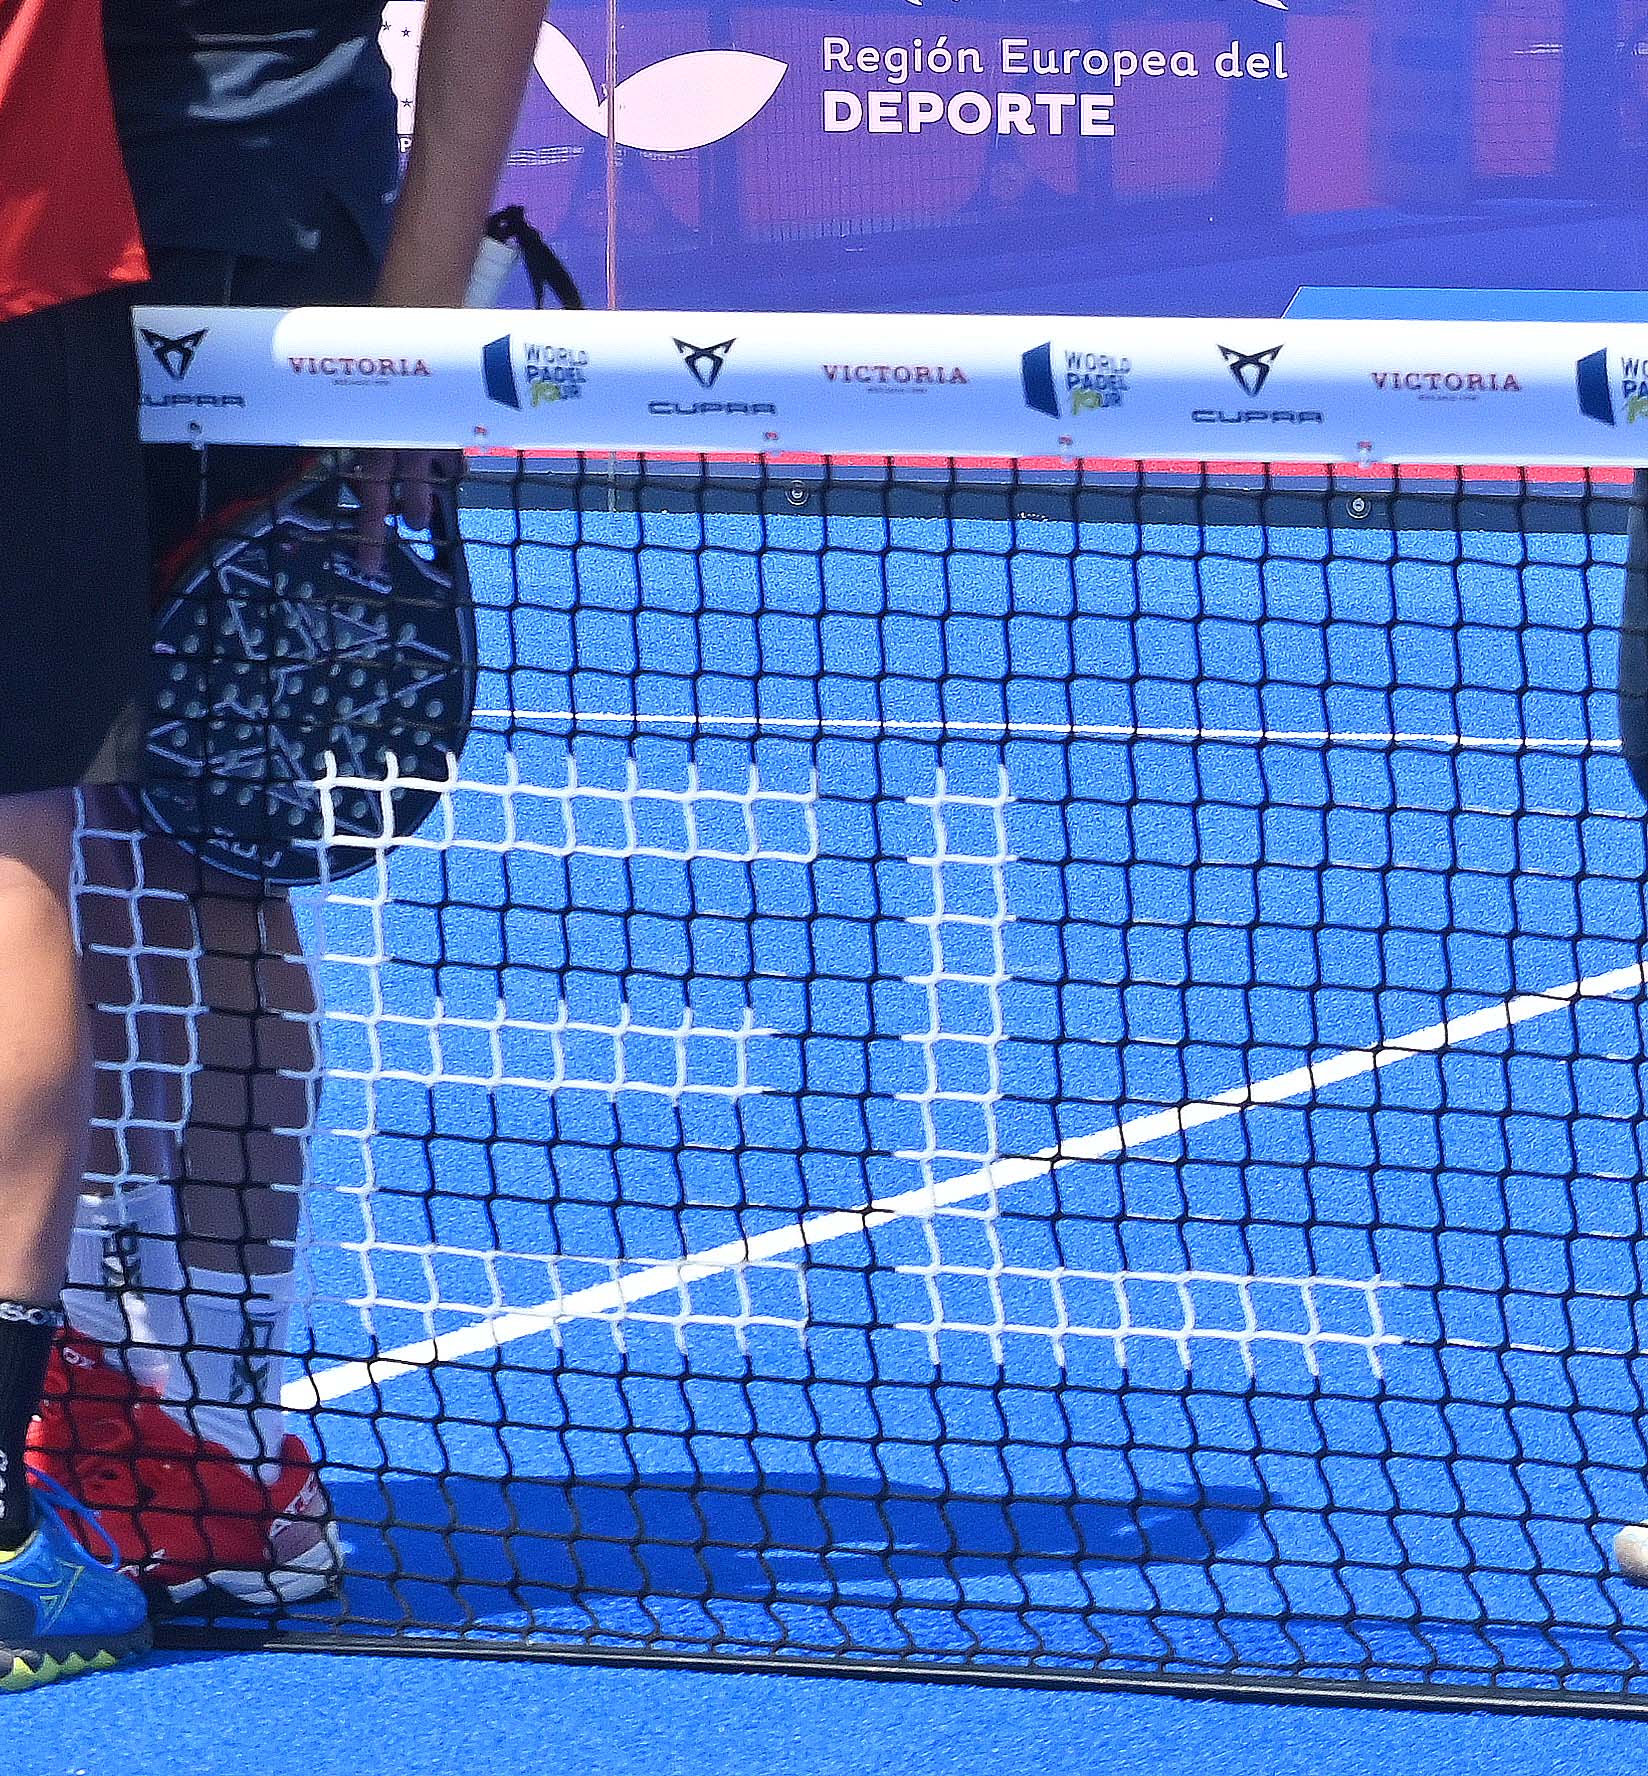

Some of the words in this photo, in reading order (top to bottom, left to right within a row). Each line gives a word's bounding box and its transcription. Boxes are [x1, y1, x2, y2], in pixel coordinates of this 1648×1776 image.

[822, 35, 985, 85] Región
[1002, 38, 1200, 88] Europea
[1214, 41, 1289, 80] del
[822, 91, 1116, 138] DEPORTE
[287, 356, 433, 378] VICTORIA
[822, 363, 971, 386] VICTORIA
[1370, 370, 1522, 393] VICTORIA
[144, 393, 248, 410] UPRA
[647, 400, 779, 416] CUPRA
[1191, 408, 1325, 425] CUPRA
